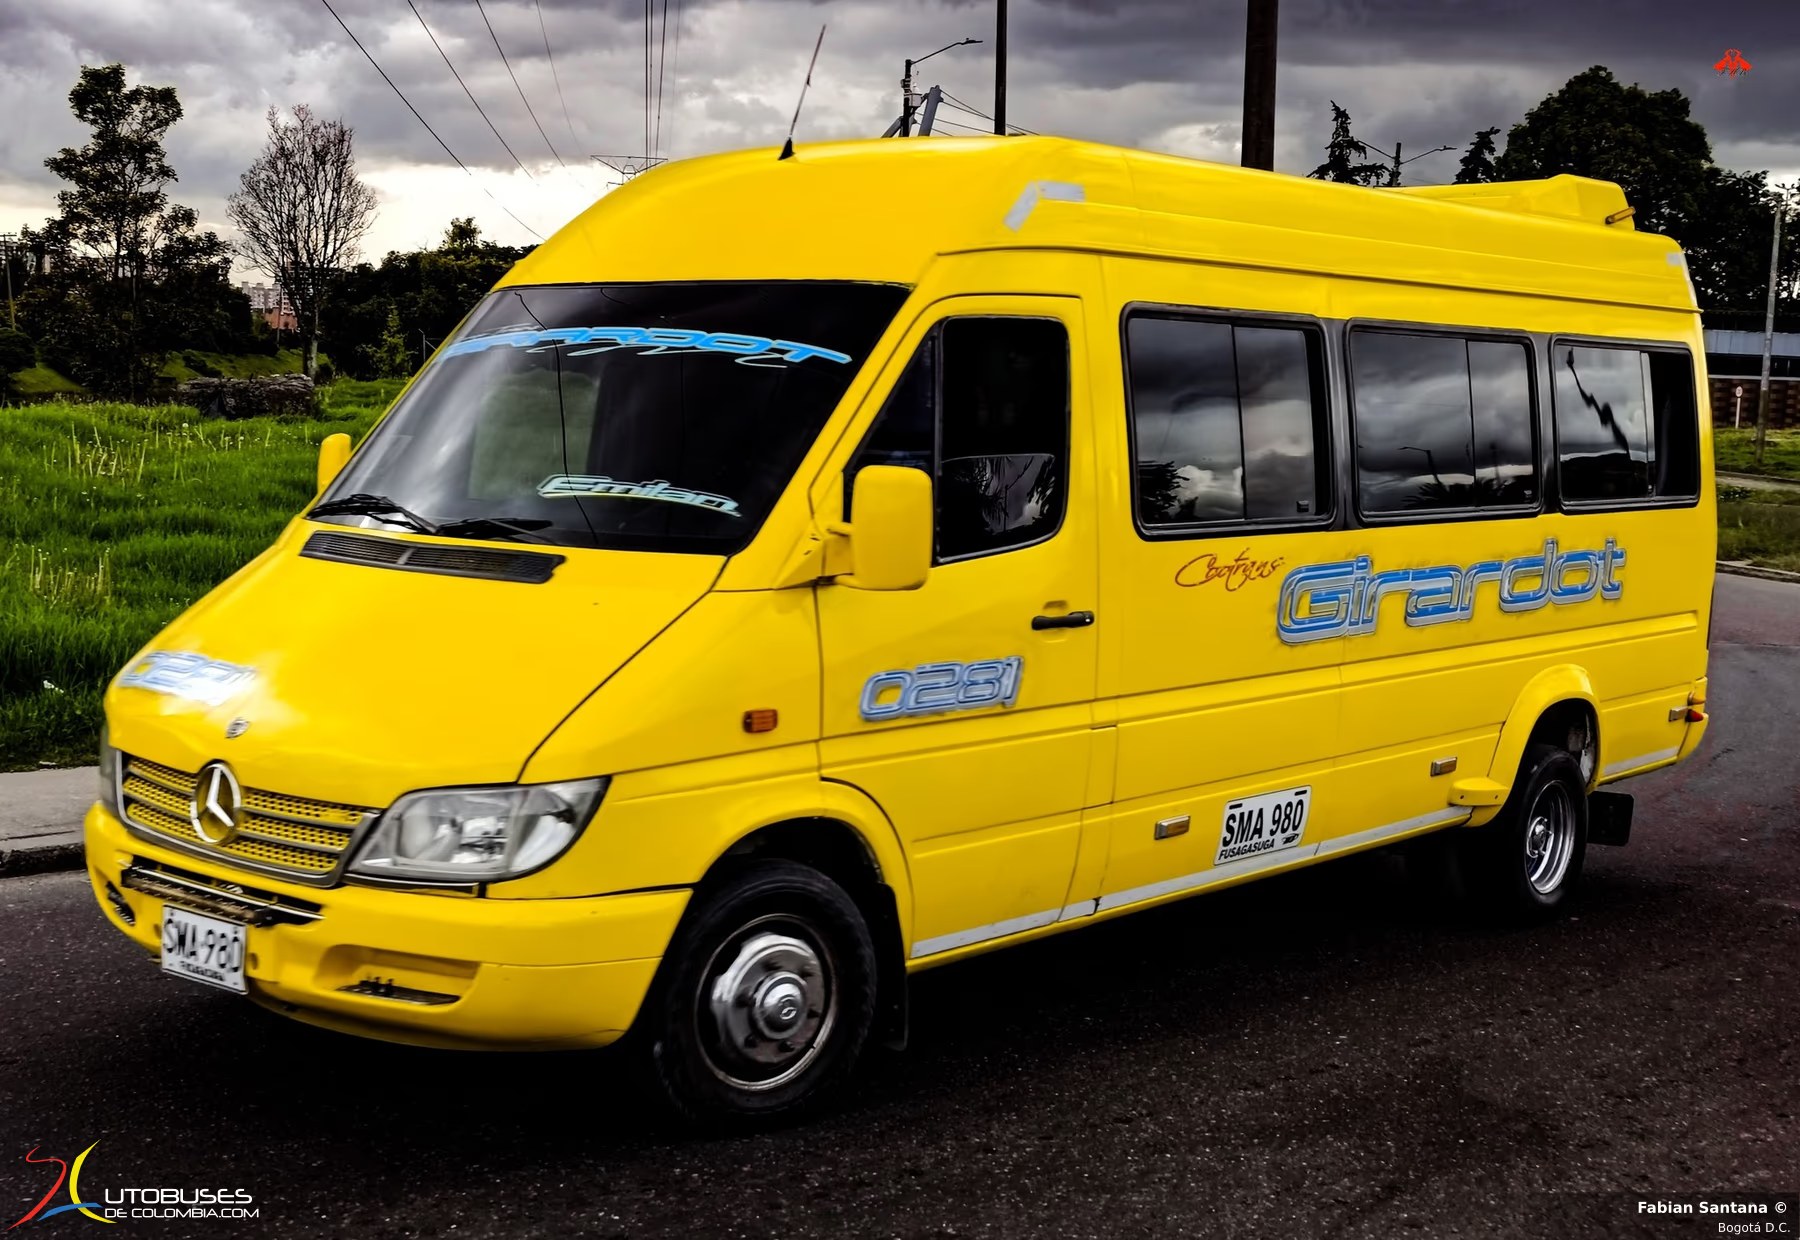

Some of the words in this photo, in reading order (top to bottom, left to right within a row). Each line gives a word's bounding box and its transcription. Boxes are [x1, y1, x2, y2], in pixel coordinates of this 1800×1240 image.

[442, 326, 853, 364] ARDOT
[1278, 538, 1625, 644] Girardot
[860, 655, 1023, 722] 0281
[1222, 808, 1264, 848] SMA
[1269, 799, 1304, 836] 980
[1218, 838, 1275, 860] FUSAGASUGA
